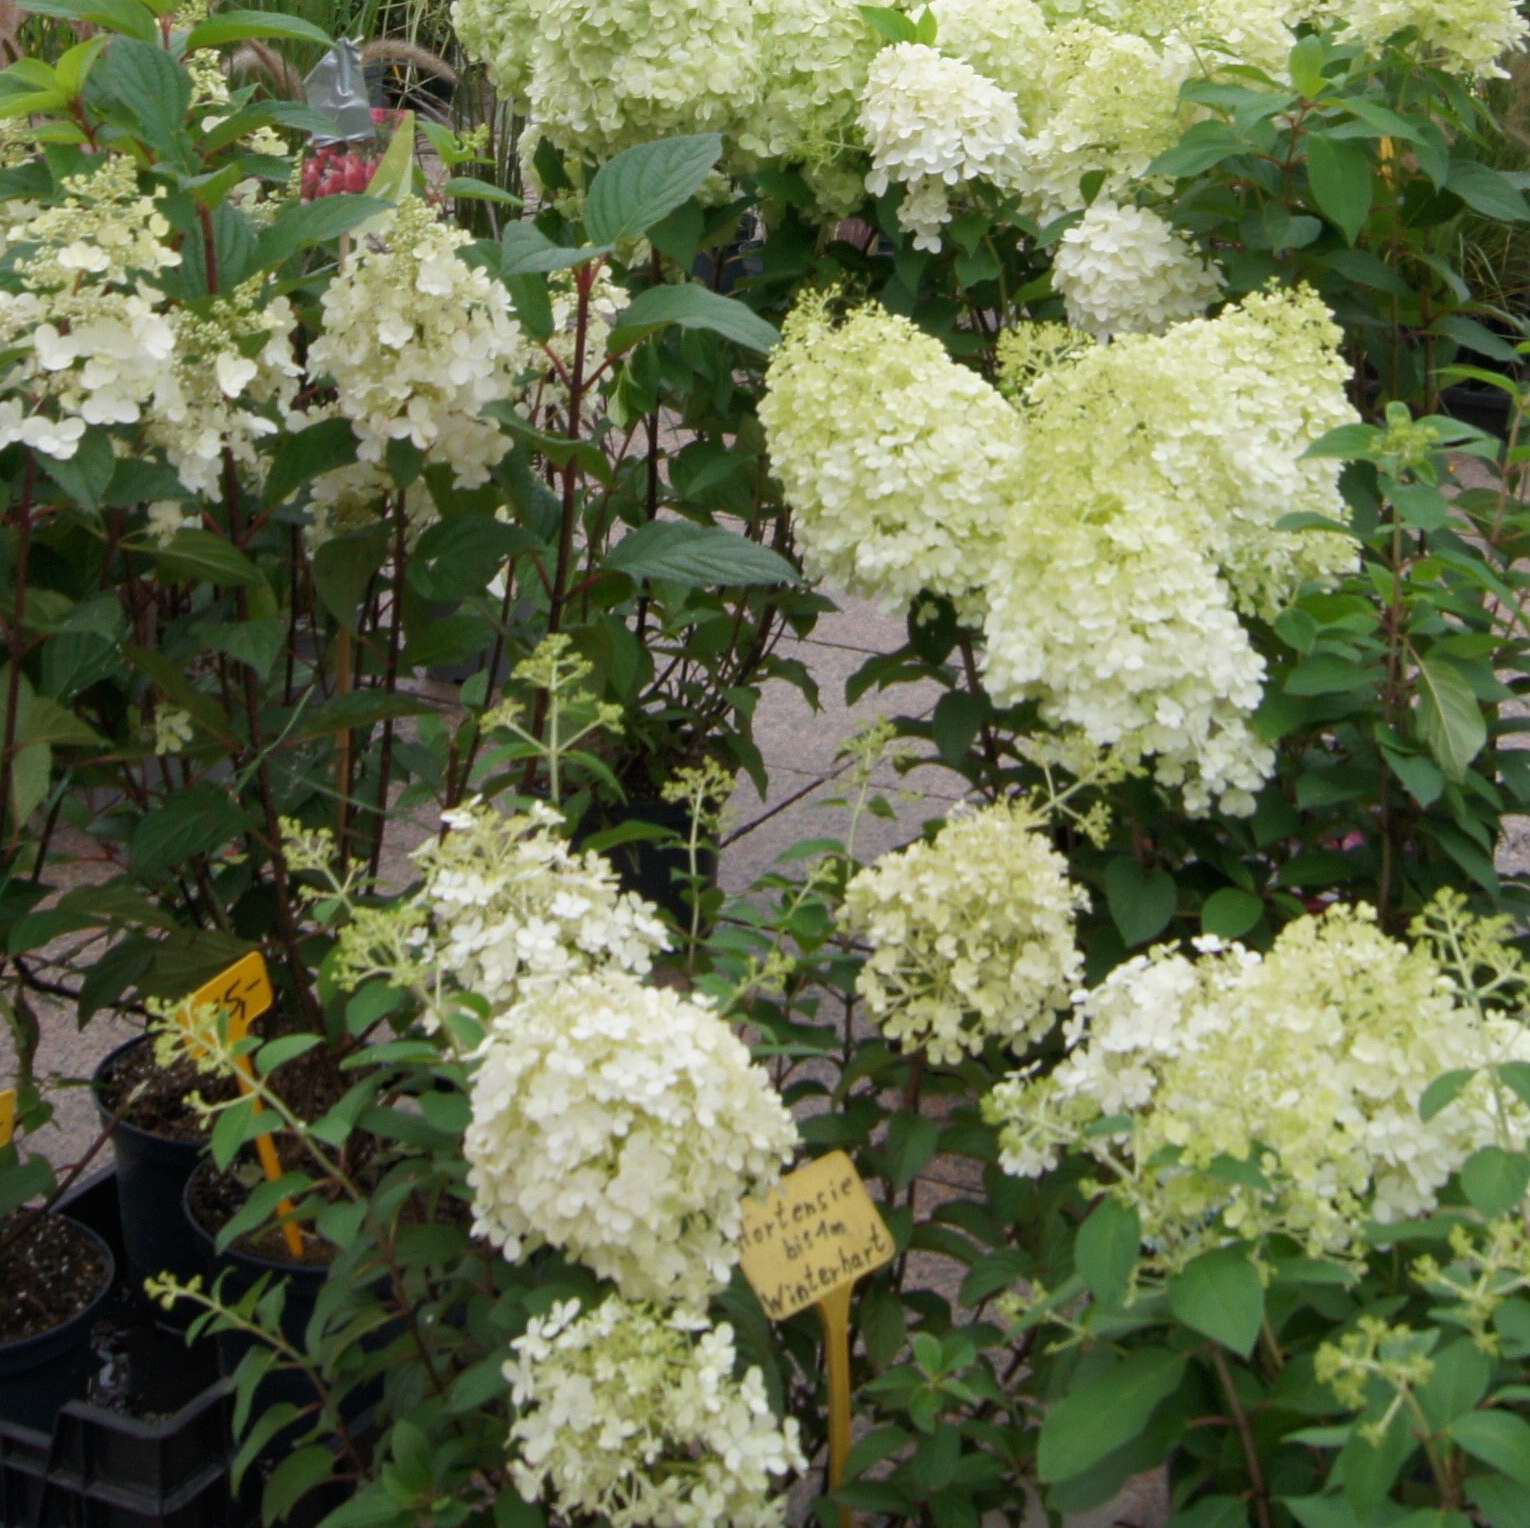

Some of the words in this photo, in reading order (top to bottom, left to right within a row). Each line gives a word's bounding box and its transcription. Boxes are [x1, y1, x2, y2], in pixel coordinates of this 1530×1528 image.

[212, 978, 262, 1021] 5,-
[781, 1230, 814, 1262] bis
[759, 1222, 887, 1314] Winterhart
